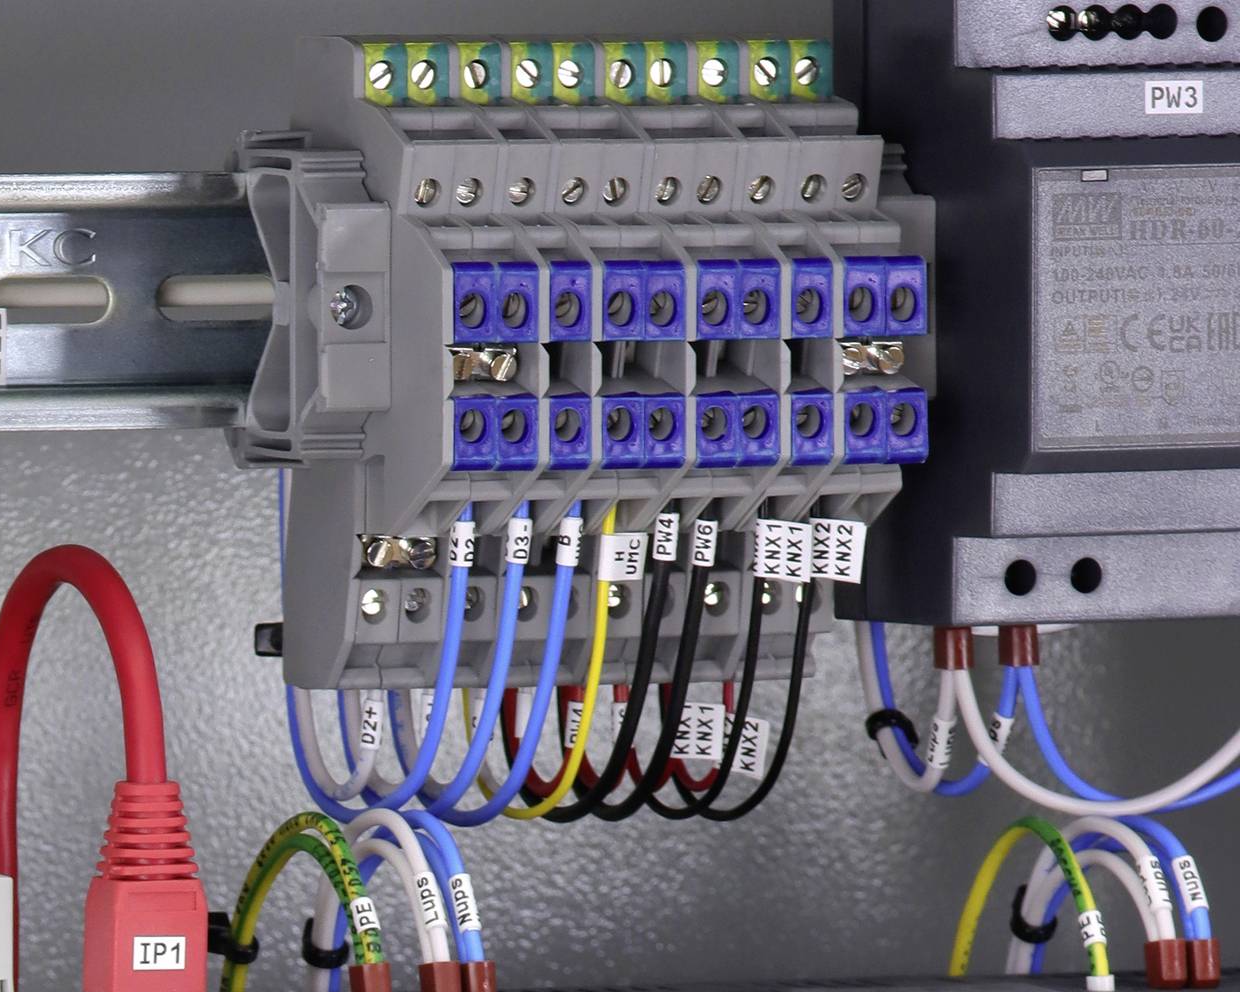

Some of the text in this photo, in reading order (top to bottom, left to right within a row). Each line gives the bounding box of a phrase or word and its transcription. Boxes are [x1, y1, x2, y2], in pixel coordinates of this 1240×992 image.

[1150, 86, 1198, 108] PW3
[514, 525, 529, 559] D3-
[657, 518, 674, 555] PW4
[695, 525, 713, 562] PW6
[765, 524, 782, 575] KNX1
[786, 527, 803, 577] KNX1
[812, 523, 831, 574] KNX2
[835, 525, 853, 576] KNX2
[626, 538, 641, 575] UMC
[362, 706, 377, 745] D2+
[696, 706, 714, 755] KNX1
[740, 721, 759, 771] KNX2
[356, 903, 376, 926] PE
[140, 943, 182, 964] IP1
